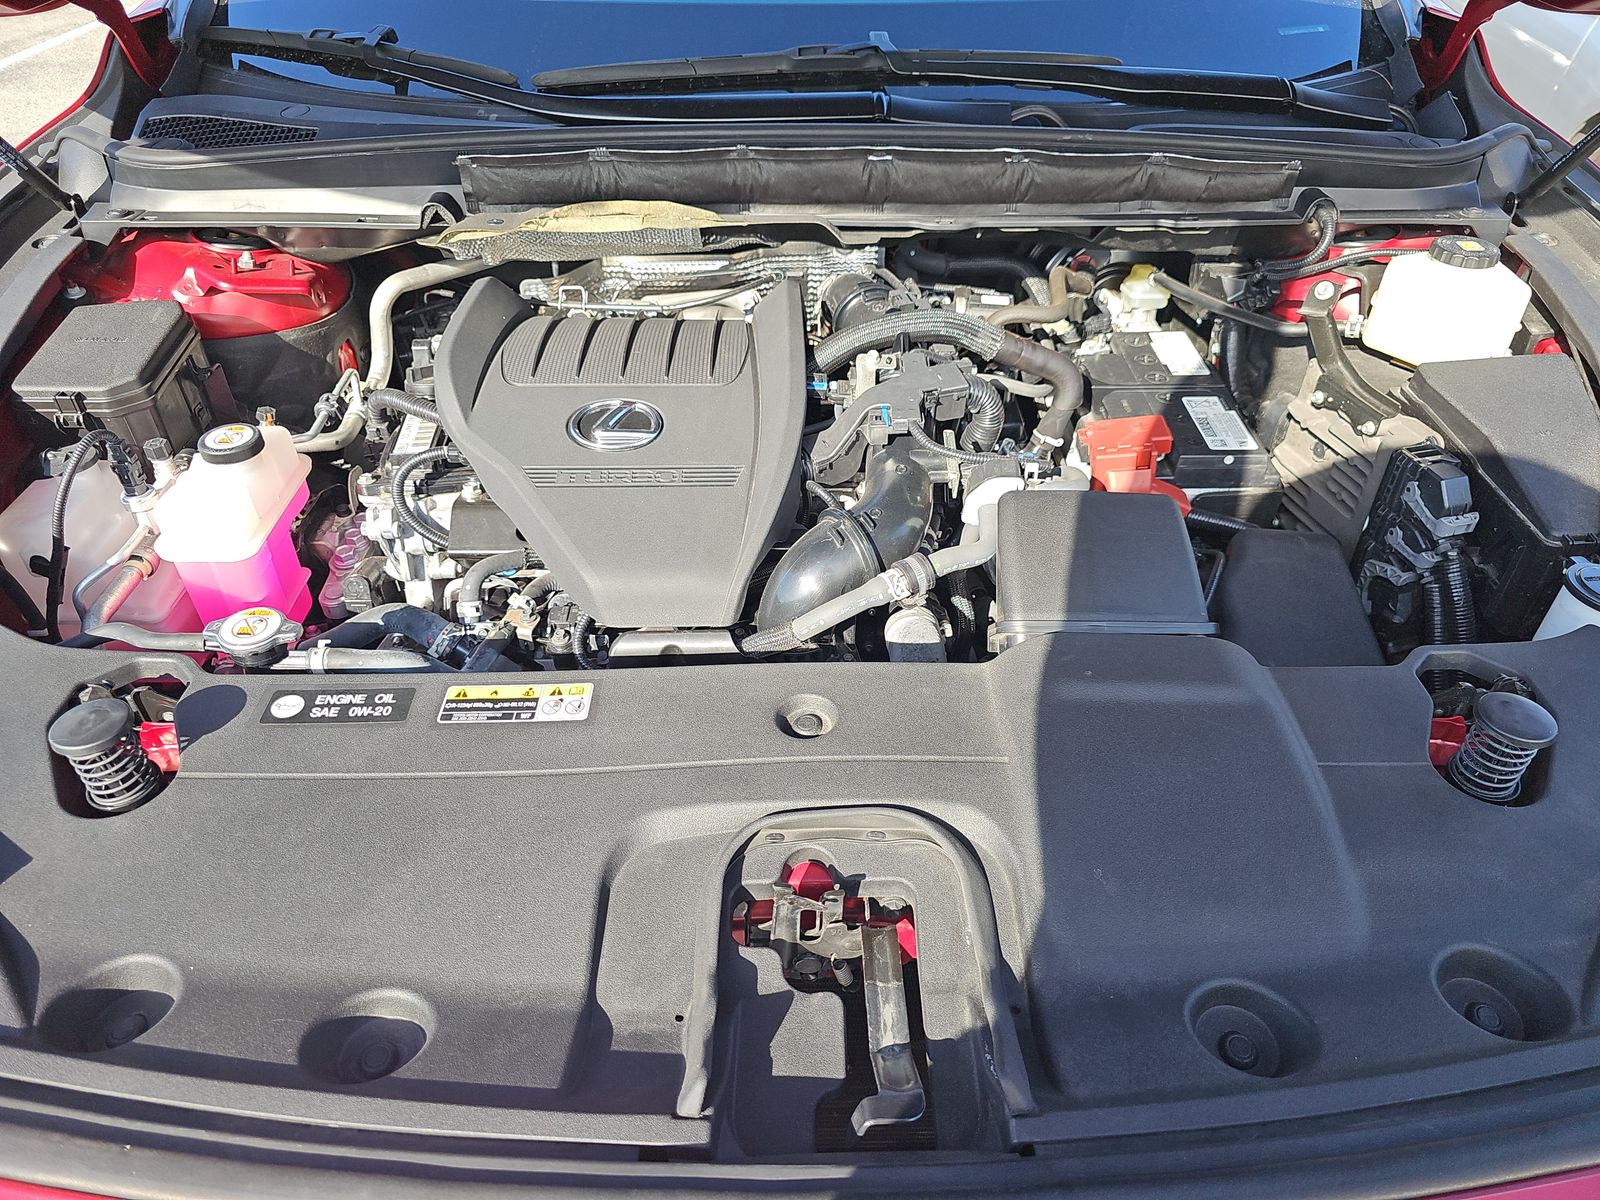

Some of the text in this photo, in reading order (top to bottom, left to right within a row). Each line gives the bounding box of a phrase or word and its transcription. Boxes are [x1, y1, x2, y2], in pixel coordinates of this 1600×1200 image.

[560, 469, 679, 483] TURBO
[314, 693, 397, 705] ENGINE OIL
[309, 706, 392, 718] SAE 0W-20
